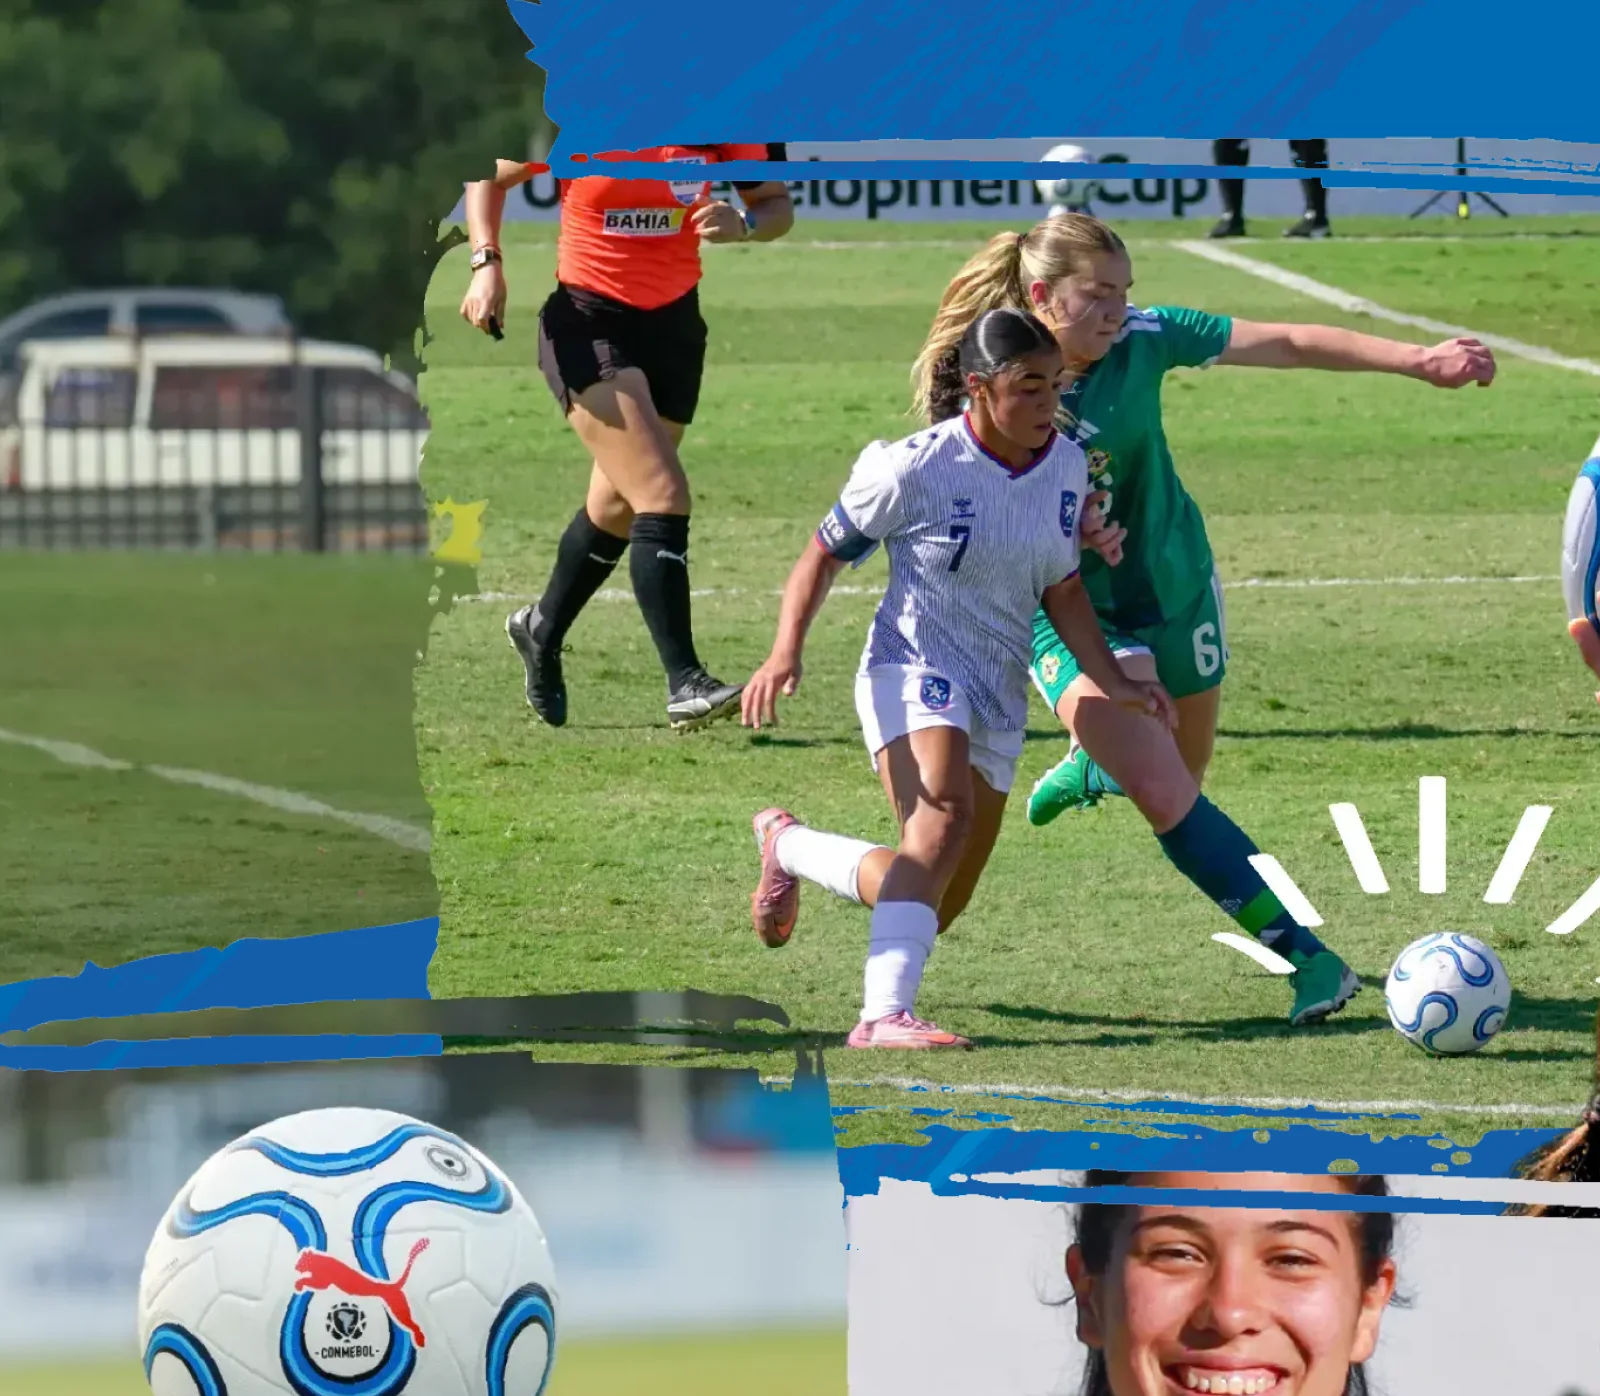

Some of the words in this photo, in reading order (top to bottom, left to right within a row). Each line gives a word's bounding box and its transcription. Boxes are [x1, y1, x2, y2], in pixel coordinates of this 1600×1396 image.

[1097, 153, 1208, 217] Cup
[606, 215, 670, 229] BAHIA
[949, 525, 970, 572] 7
[1192, 622, 1220, 677] 6
